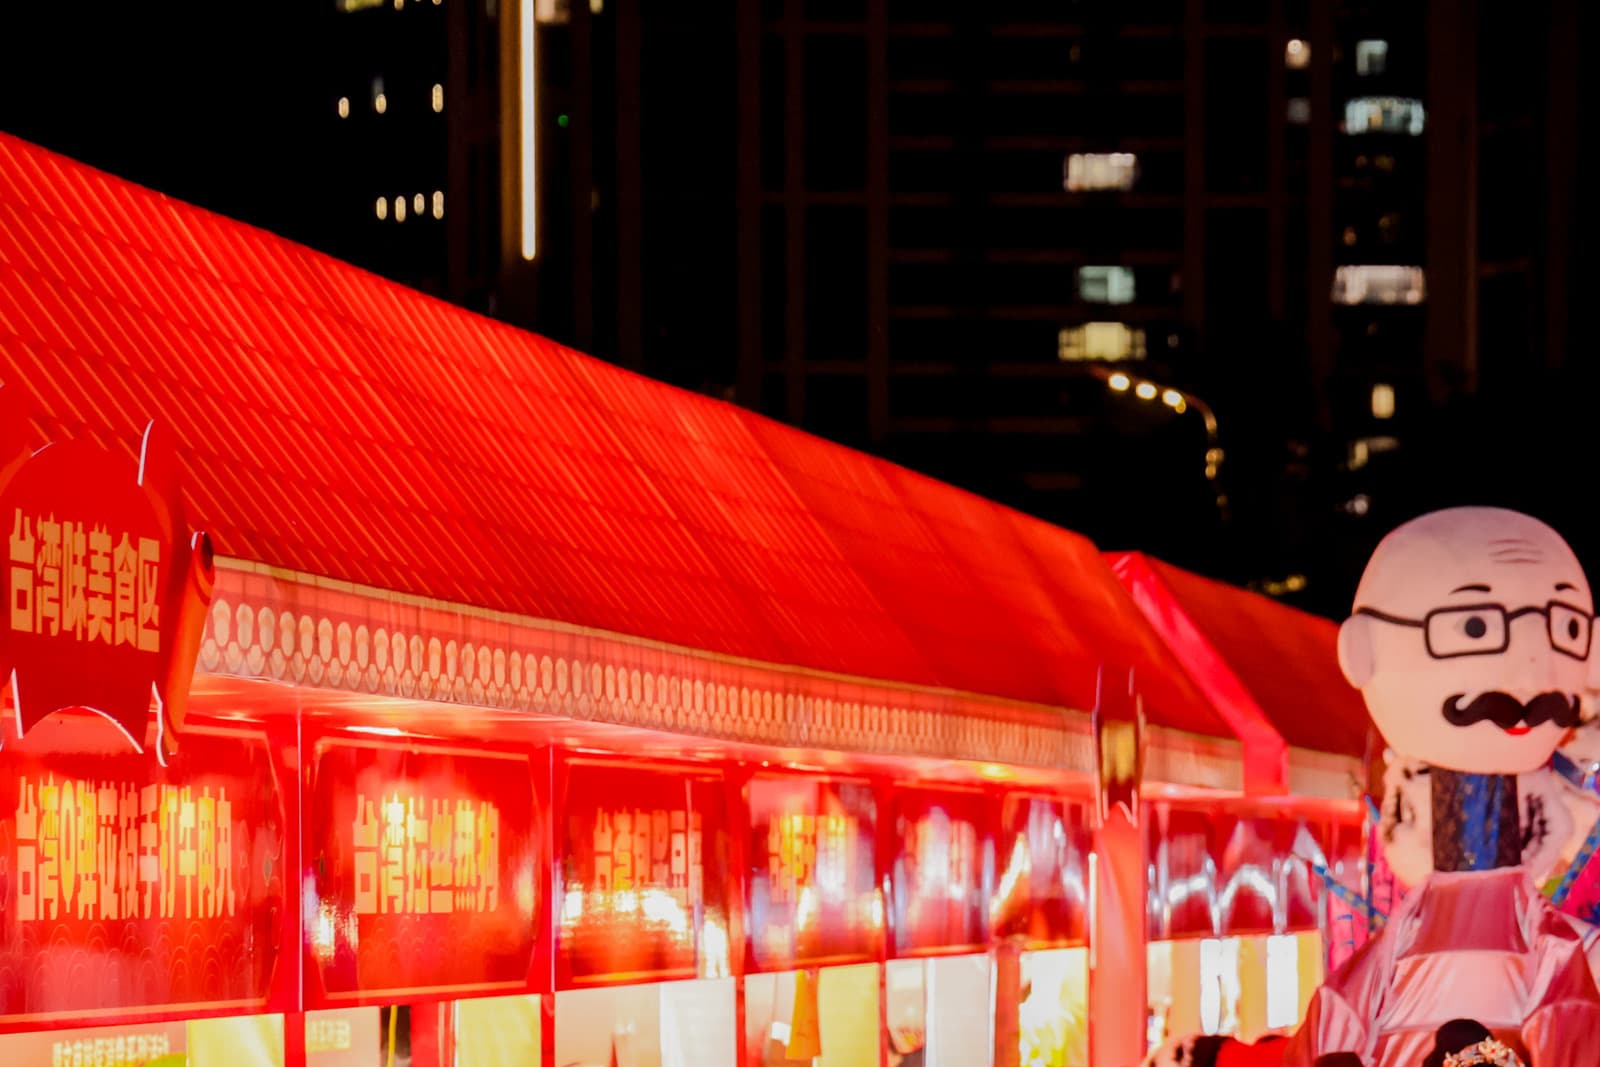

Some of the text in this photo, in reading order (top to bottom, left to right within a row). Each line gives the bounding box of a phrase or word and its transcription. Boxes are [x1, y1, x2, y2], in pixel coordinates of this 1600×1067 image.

[9, 507, 160, 653] 台湾味美食区
[353, 792, 500, 914] 台湾拉丝热狗
